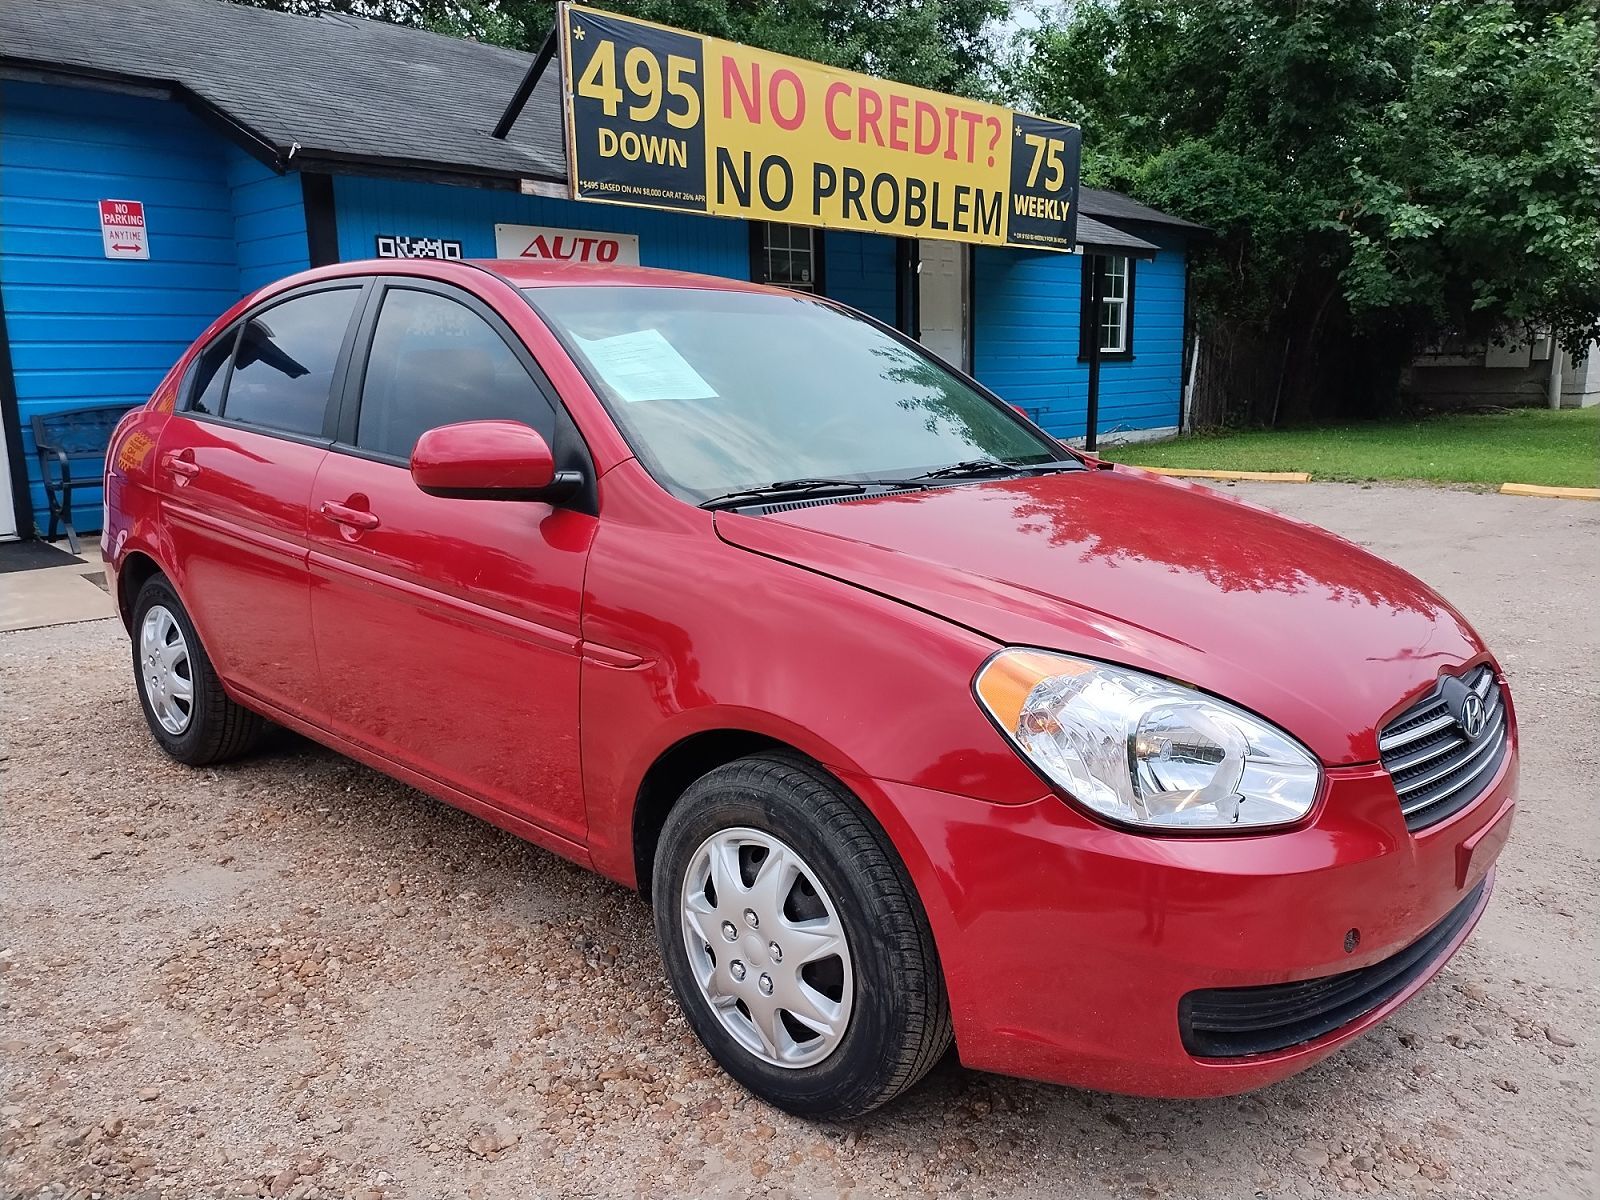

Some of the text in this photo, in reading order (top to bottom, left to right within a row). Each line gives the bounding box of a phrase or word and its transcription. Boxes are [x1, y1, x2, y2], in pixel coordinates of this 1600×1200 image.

[721, 55, 1003, 168] NO CREDIT?
[598, 127, 688, 169] DOWN
[600, 182, 620, 192] BASED
[621, 185, 631, 193] ON
[632, 186, 642, 195] AN
[662, 190, 673, 199] CAR
[674, 191, 682, 200] AT
[694, 194, 706, 203] APR
[716, 146, 1003, 237] NO PROBLEM
[104, 214, 143, 226] PARKING
[115, 203, 128, 214] NO
[1014, 193, 1070, 222] WEEKLY
[109, 230, 141, 241] ANYTIME
[520, 234, 619, 263] AUTO
